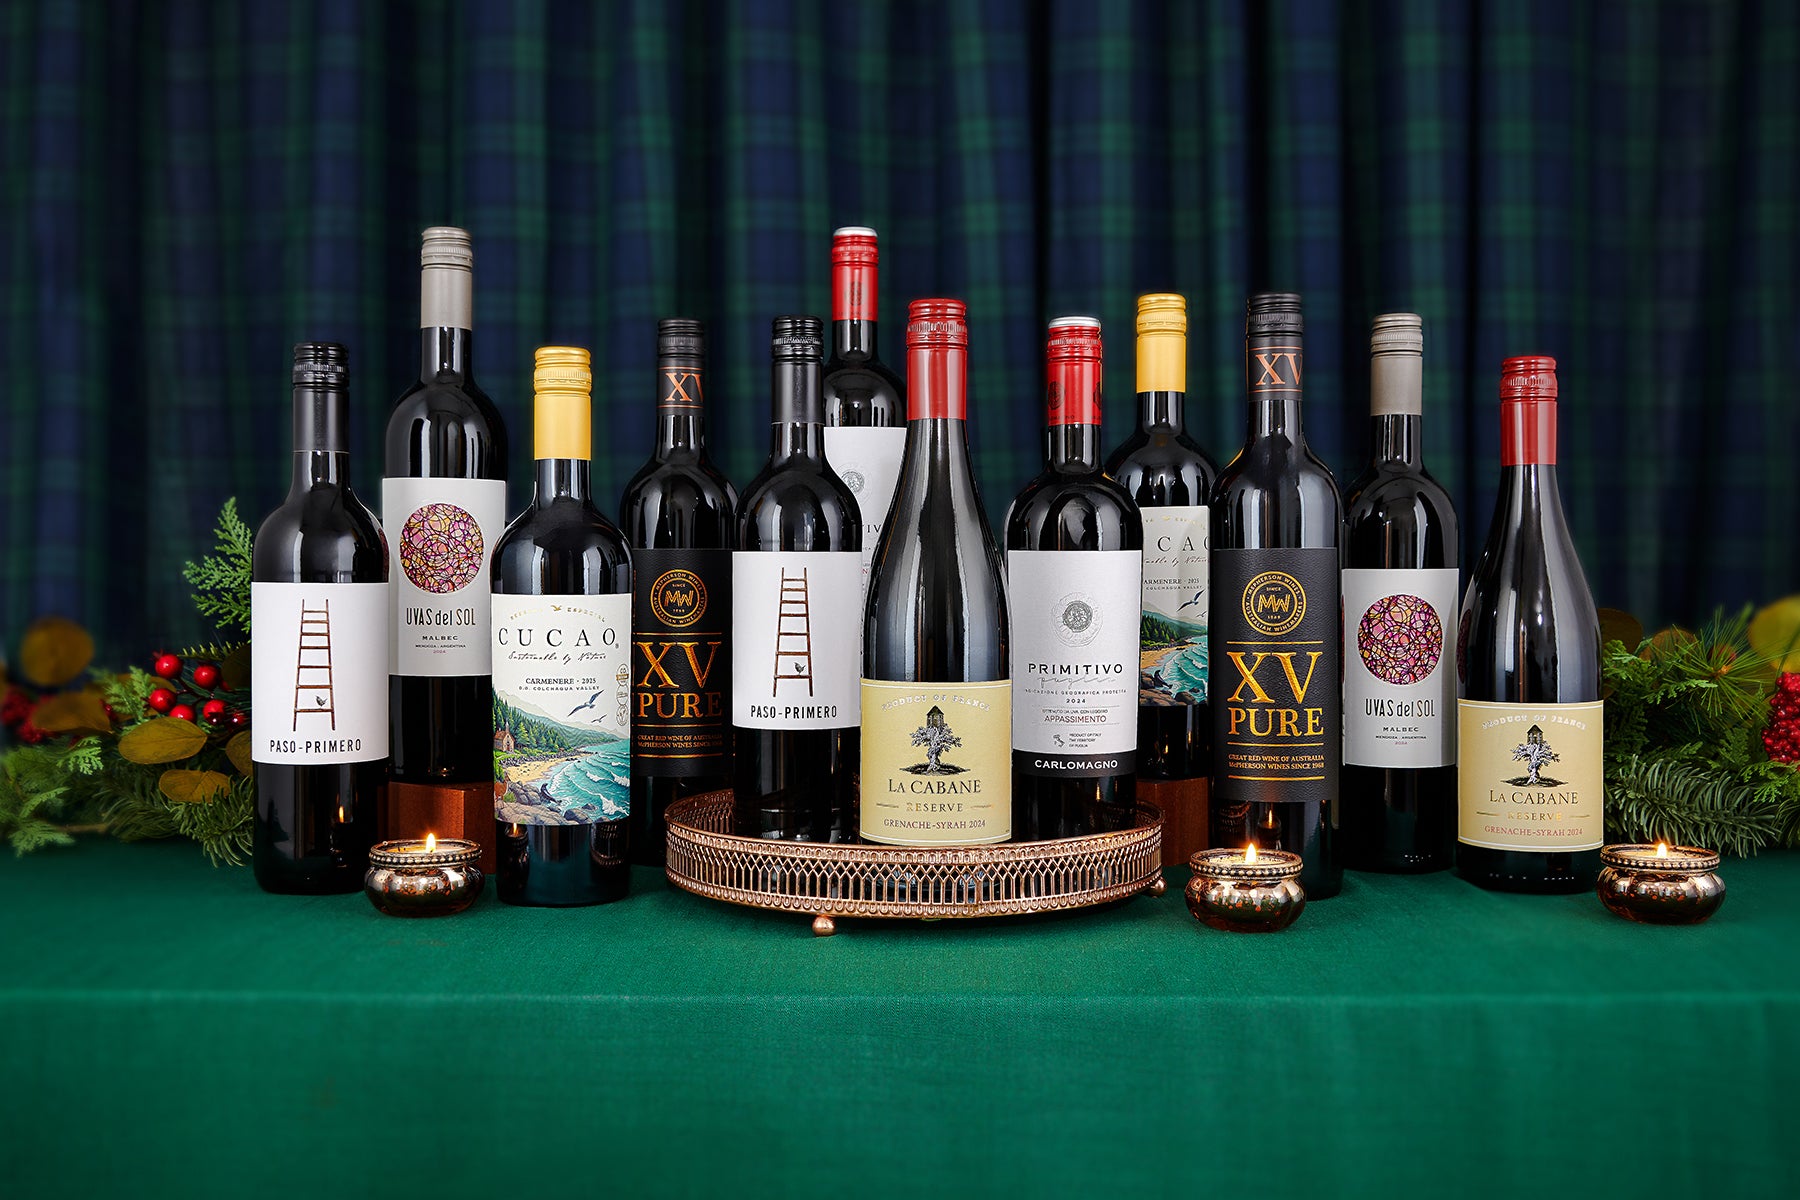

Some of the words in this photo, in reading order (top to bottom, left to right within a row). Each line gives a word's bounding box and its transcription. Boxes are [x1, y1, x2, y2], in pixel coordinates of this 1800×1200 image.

[1256, 353, 1302, 386] XV
[1284, 577, 1300, 594] WINES
[1257, 594, 1290, 612] MW
[406, 607, 432, 626] UVAS
[435, 610, 452, 626] del
[456, 608, 476, 626] SOL
[636, 642, 722, 688] XV
[1028, 663, 1122, 675] PRIMITIVO
[1226, 651, 1323, 704] XV
[638, 692, 722, 718] PURE
[882, 694, 926, 712] PRODUCT
[1365, 698, 1394, 717] UVAS
[1396, 700, 1414, 717] del
[1416, 699, 1435, 718] SOL
[1044, 715, 1106, 723] APPASSIMENTO
[1228, 706, 1324, 737] PURE
[1034, 760, 1118, 770] CARLOMAGNO
[910, 780, 982, 794] CABANE
[1511, 791, 1578, 804] CABANE
[906, 802, 964, 812] RESERVE
[884, 818, 966, 830] GRENACHE-SYRAH
[968, 819, 986, 828] 2024
[1508, 812, 1562, 821] RESERVE
[1484, 824, 1564, 836] GRENACHE-SYRAH
[1567, 828, 1582, 836] 2024
